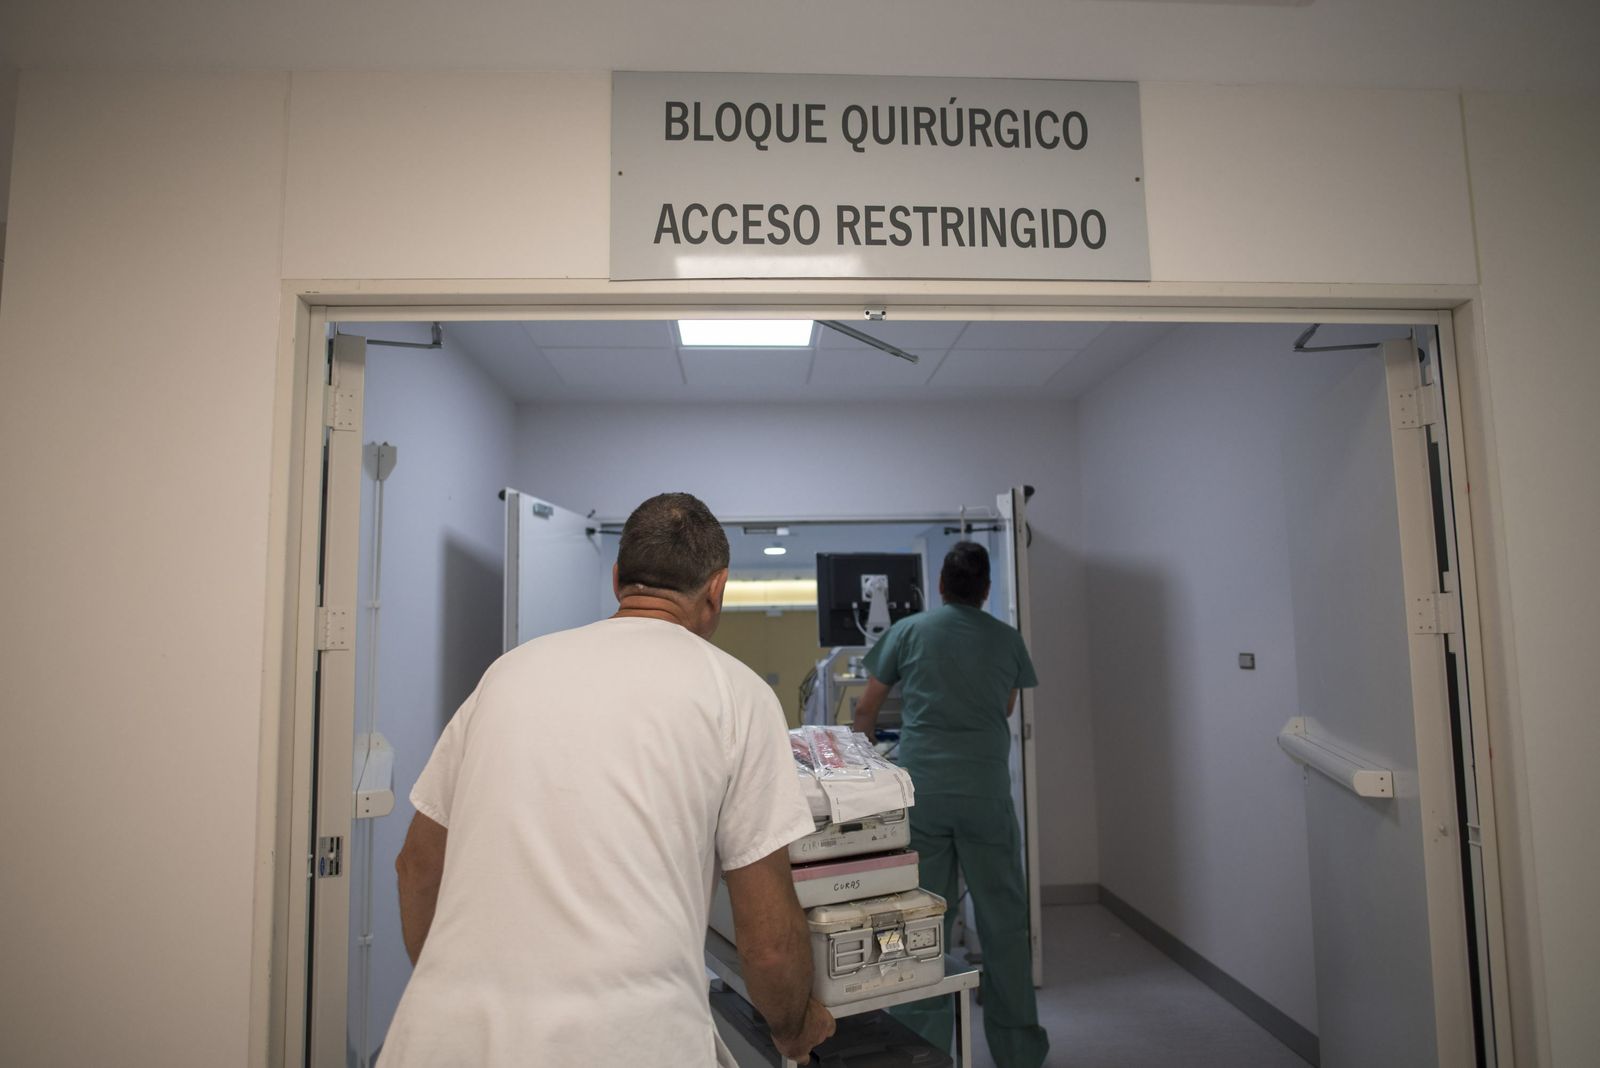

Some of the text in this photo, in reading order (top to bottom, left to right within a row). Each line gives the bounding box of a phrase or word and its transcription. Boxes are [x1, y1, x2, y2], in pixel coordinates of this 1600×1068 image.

[664, 97, 1089, 153] BLOQUE QUIRÚRGICO
[653, 203, 1107, 250] ACCESO RESTRINGIDO
[833, 879, 861, 892] CURAS
